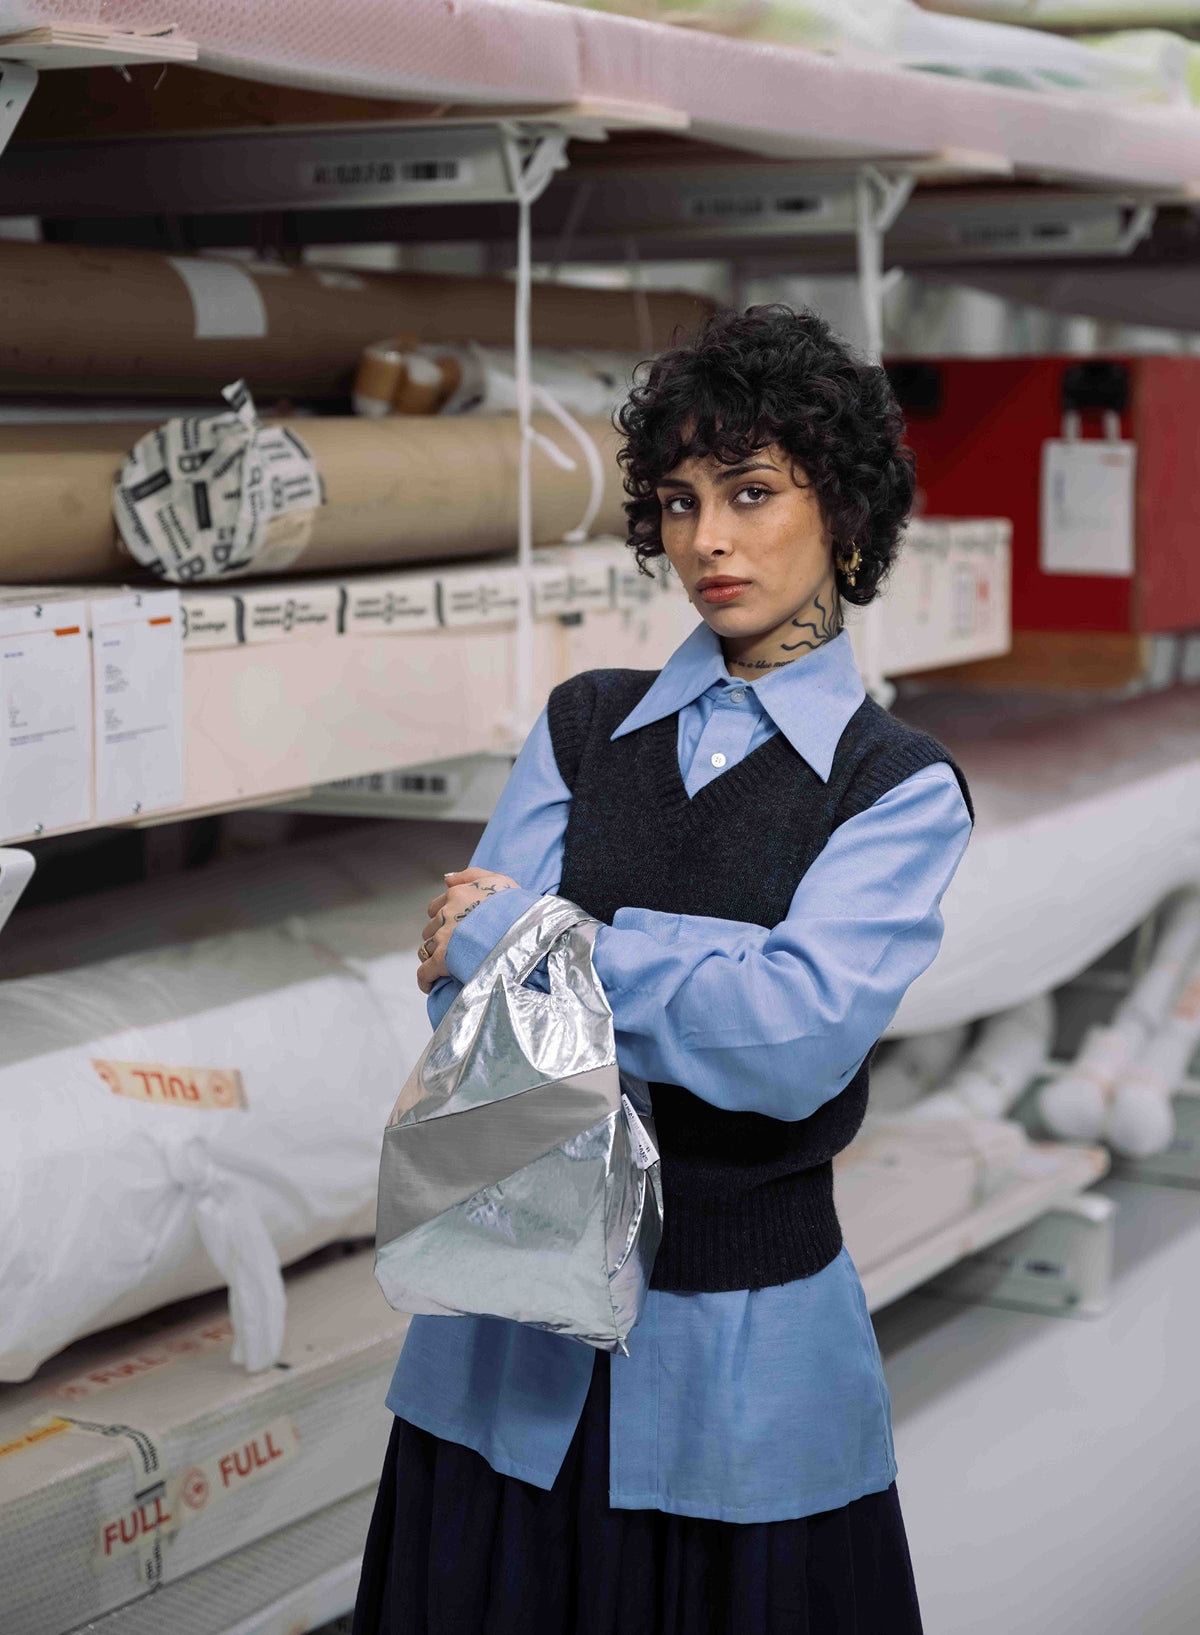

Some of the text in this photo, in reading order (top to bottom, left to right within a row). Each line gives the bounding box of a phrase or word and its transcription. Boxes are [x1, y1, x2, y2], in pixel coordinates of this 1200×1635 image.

[130, 1069, 201, 1102] FULL
[218, 1433, 283, 1488] FULL
[103, 1497, 172, 1556] FULL
